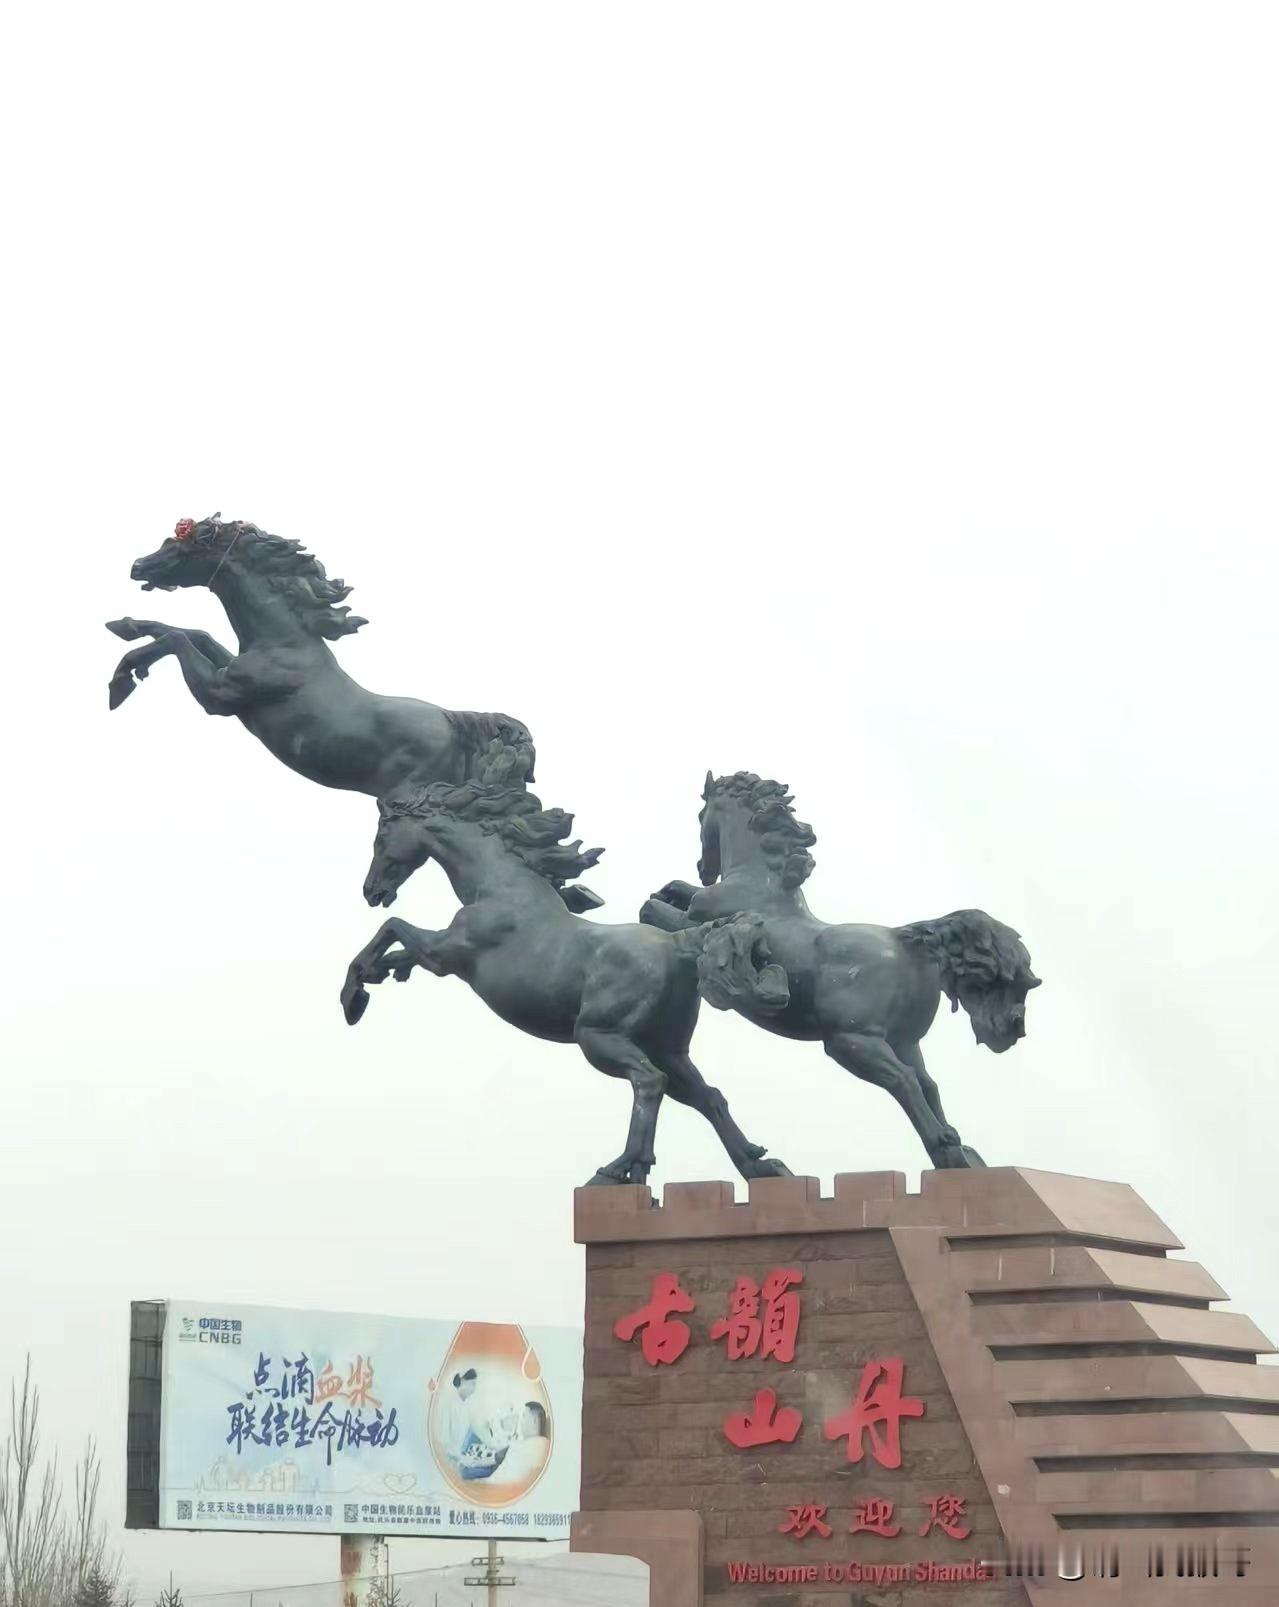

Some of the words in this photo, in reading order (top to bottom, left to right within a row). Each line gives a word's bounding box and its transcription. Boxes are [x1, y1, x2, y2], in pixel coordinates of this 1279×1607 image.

[199, 1317, 242, 1332] 中国生物
[199, 1332, 242, 1345] CNBG
[246, 1352, 382, 1408] 点滴血浆
[723, 1357, 925, 1469] 山丹
[226, 1401, 399, 1466] 联结生命脉动
[197, 1501, 333, 1517] 北京天坛生物制品股份有限公司
[779, 1495, 972, 1540] 欢迎您
[727, 1560, 818, 1582] Welcome
[823, 1561, 841, 1581] to
[846, 1560, 911, 1585] Guyun
[914, 1558, 994, 1581] Shanda
